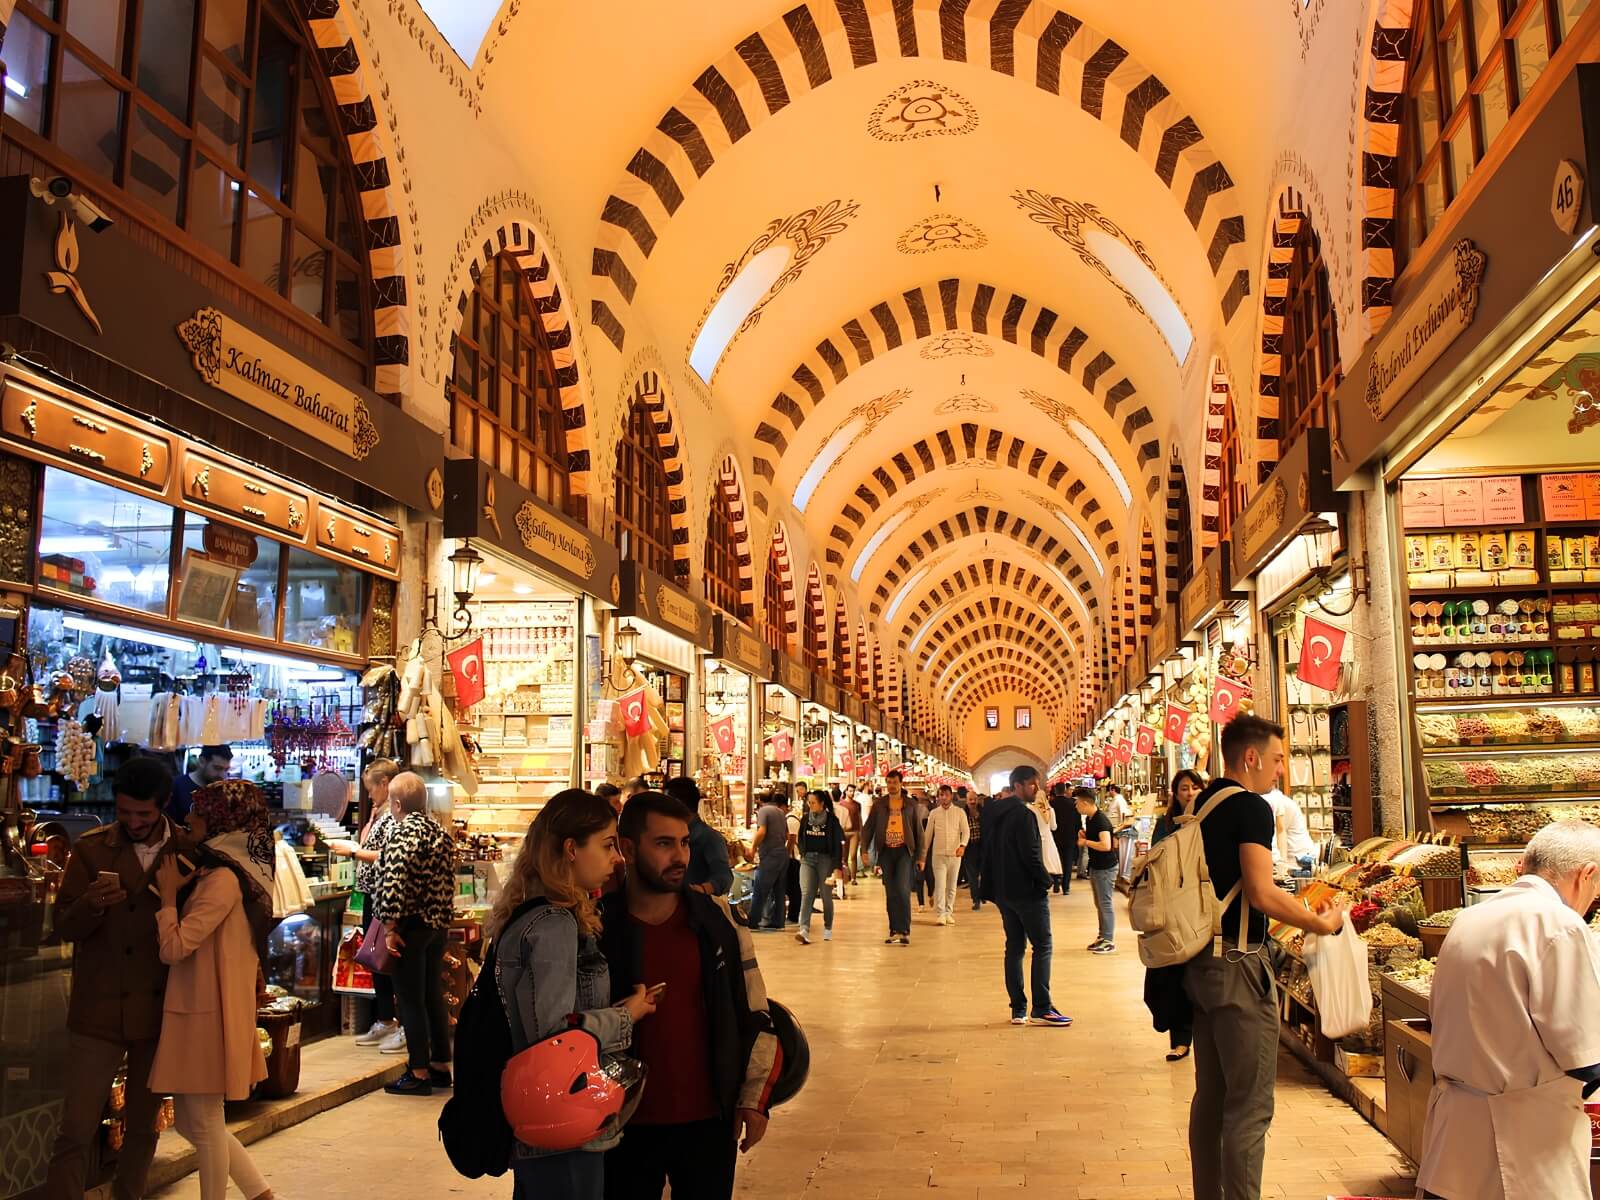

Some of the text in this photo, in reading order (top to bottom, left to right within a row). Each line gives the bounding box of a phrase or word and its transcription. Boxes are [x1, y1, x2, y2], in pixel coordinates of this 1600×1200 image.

[1556, 174, 1574, 214] 46
[1412, 287, 1456, 356] Exclusive
[225, 347, 349, 433] Kalmaz Baharat
[531, 518, 557, 551] Gallery
